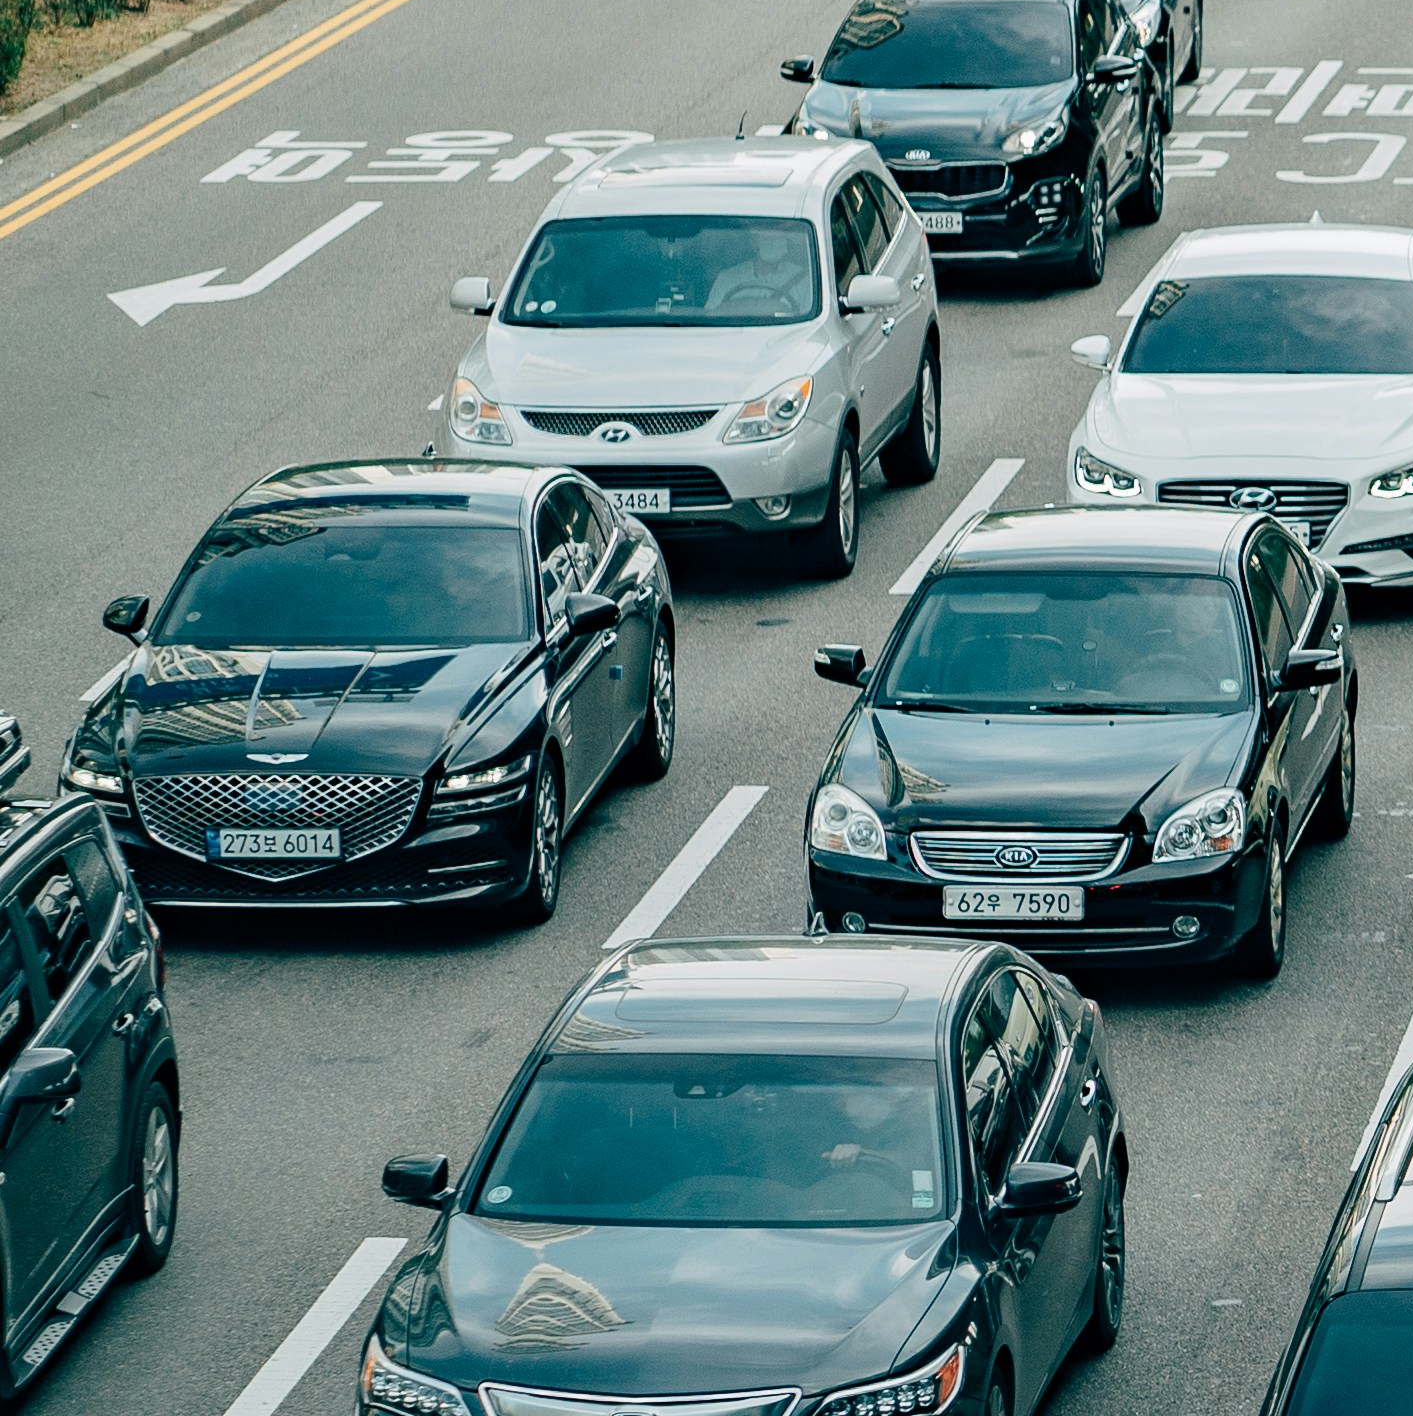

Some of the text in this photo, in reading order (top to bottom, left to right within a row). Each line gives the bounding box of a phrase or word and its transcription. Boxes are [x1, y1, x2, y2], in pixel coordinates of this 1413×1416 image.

[613, 493, 659, 509] 3484
[283, 833, 334, 854] 6014
[957, 892, 1070, 914] 62우 7590
